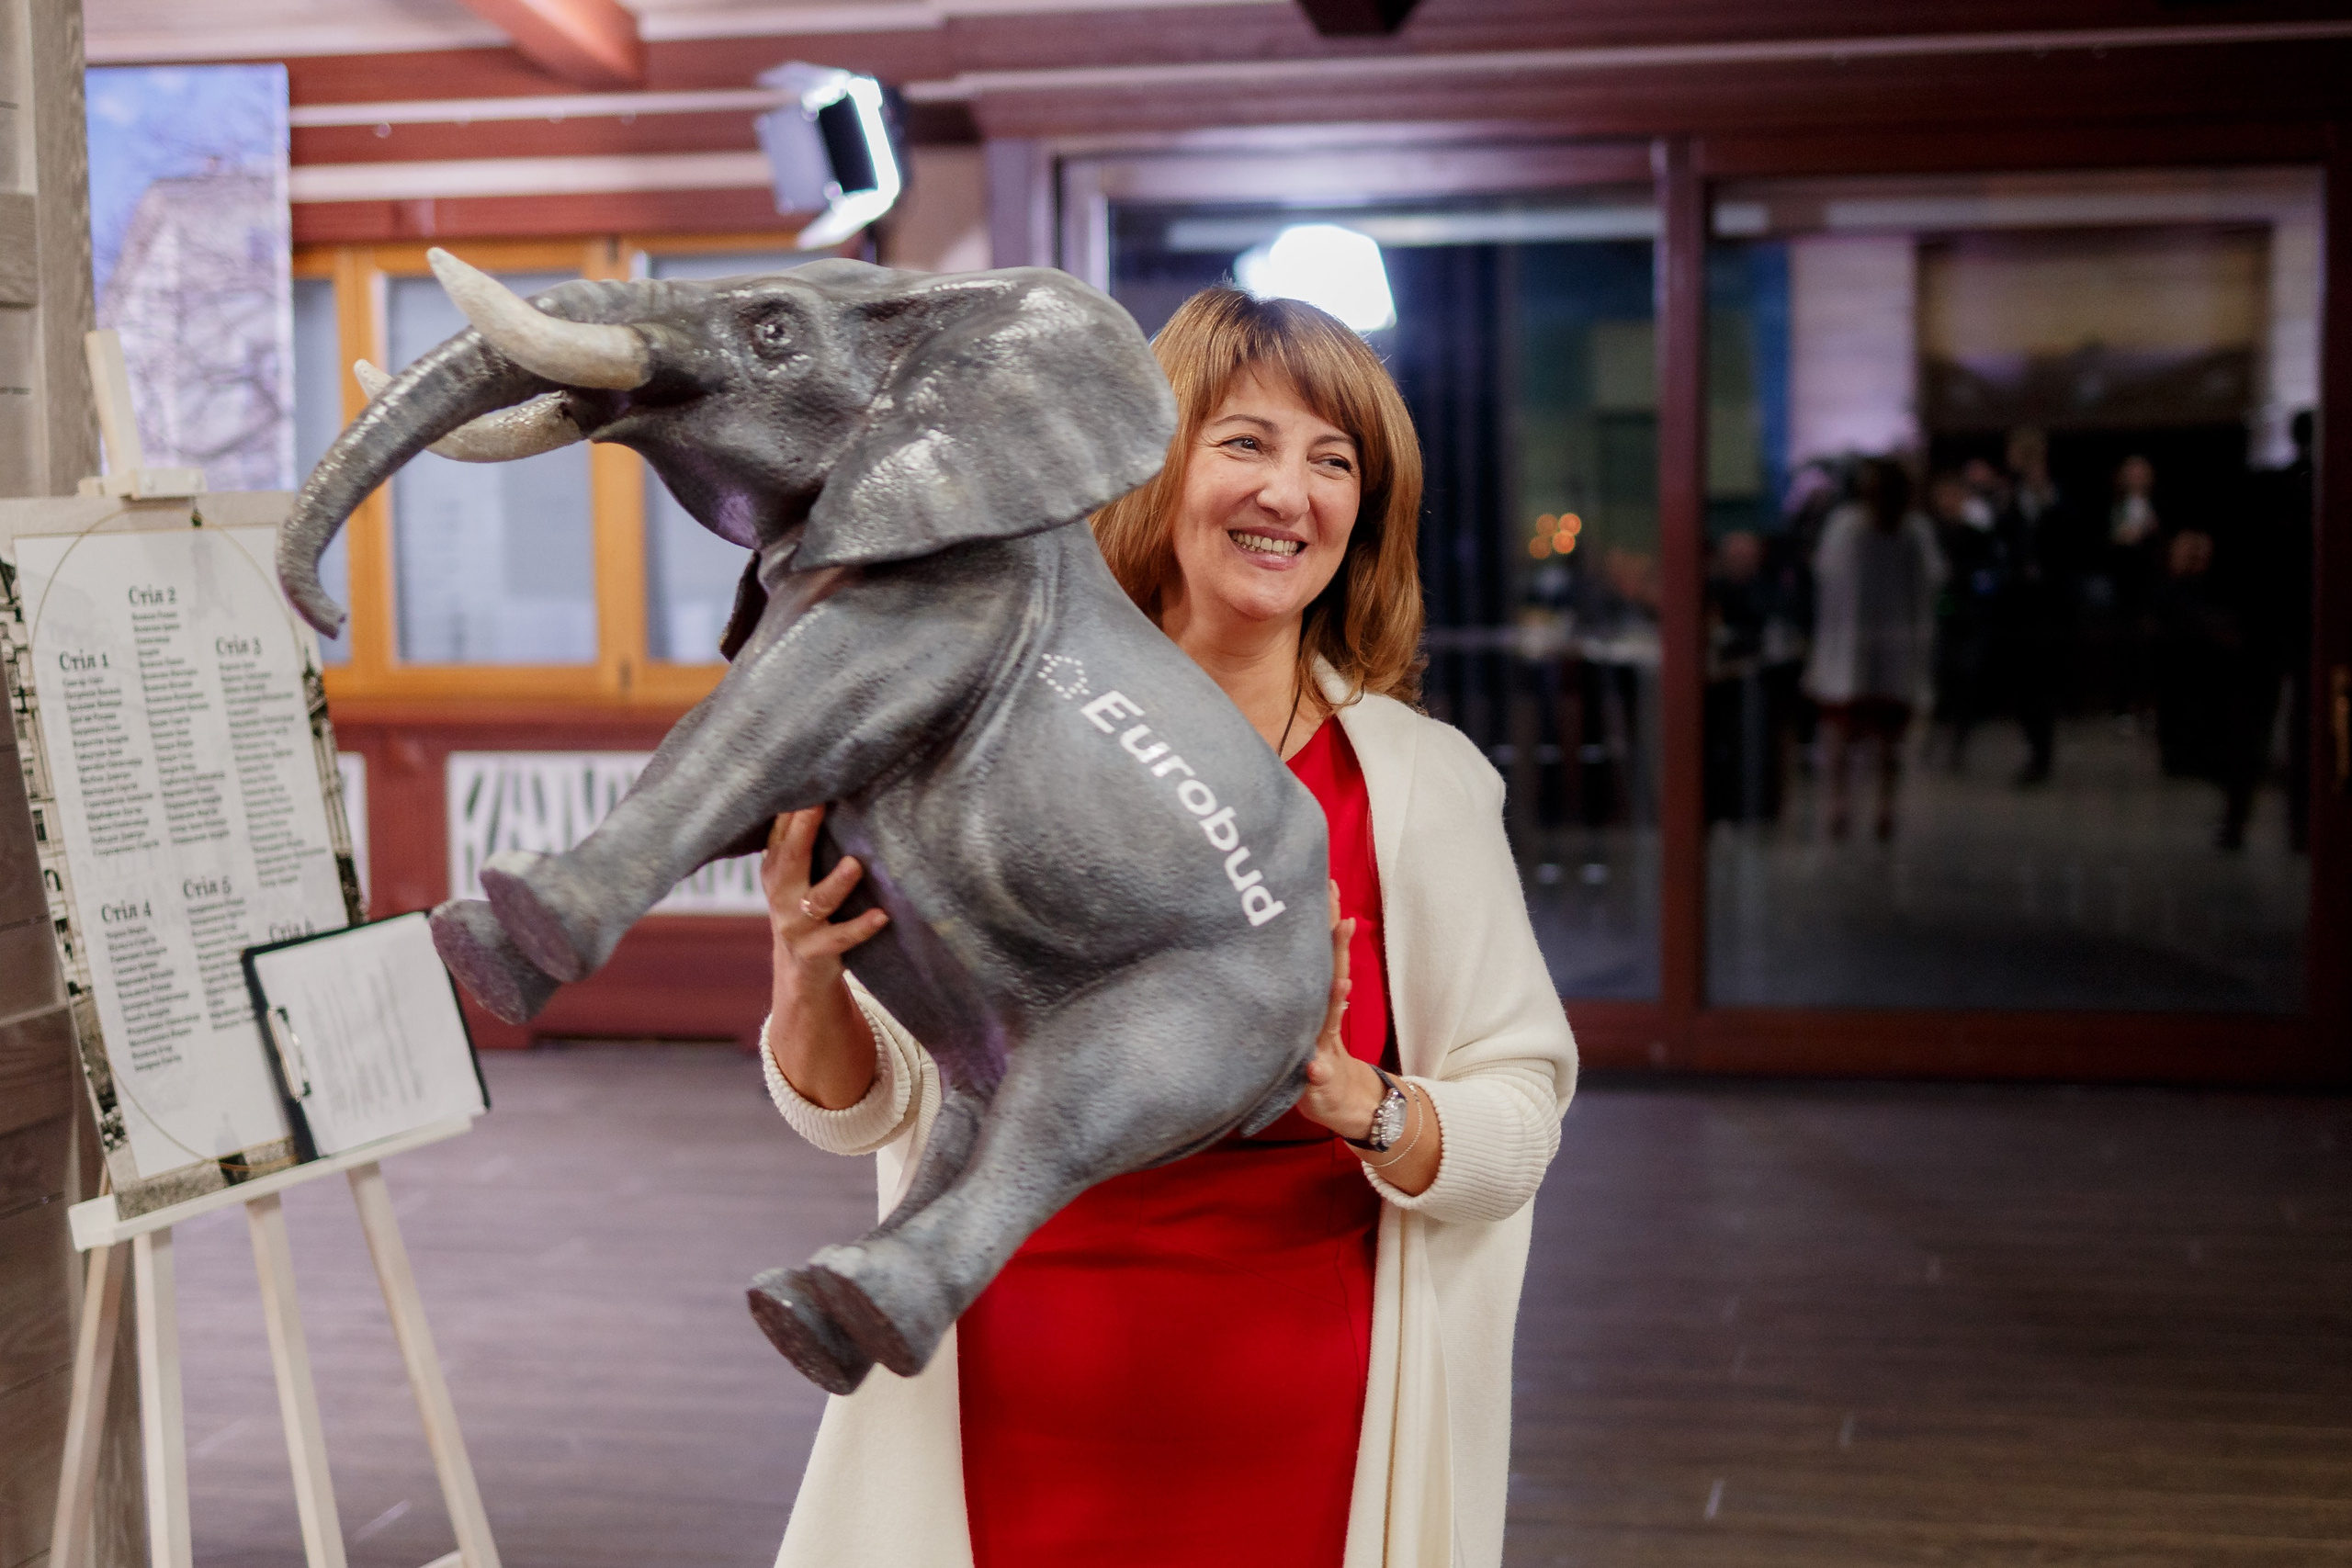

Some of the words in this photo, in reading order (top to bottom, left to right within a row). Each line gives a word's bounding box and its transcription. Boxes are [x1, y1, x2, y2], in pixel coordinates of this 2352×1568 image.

[129, 584, 164, 606] Стіл
[167, 586, 177, 604] 2
[253, 637, 262, 657] 3
[59, 649, 96, 671] Стіл
[101, 652, 109, 670] 1
[1080, 690, 1286, 927] Eurobud
[221, 874, 232, 896] 5
[101, 899, 138, 924] Стіл
[142, 899, 153, 918] 4
